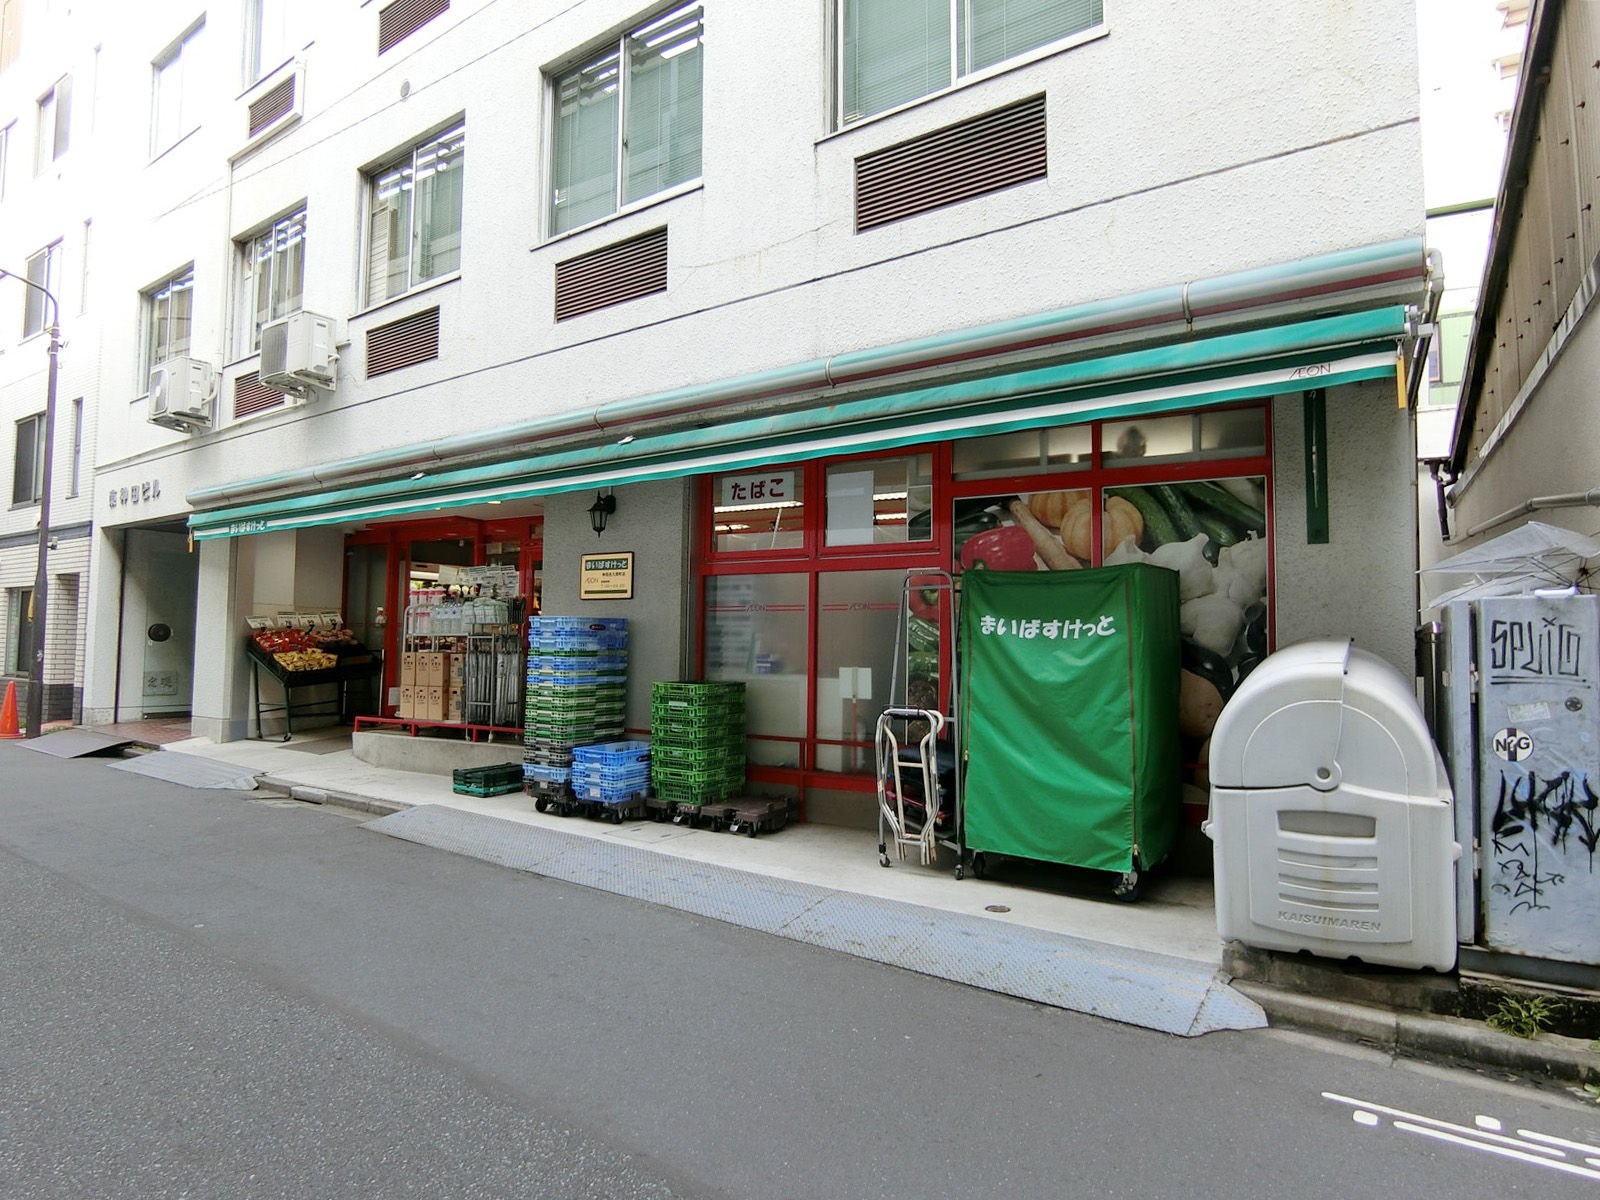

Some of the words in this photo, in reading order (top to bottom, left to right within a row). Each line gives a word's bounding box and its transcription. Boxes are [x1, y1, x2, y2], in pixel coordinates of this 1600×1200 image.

[731, 478, 785, 501] たばこ
[230, 520, 266, 534] まいばすけっと
[585, 560, 628, 570] まいばすけっと
[980, 614, 1117, 640] まいばすけっと
[1278, 911, 1381, 933] KAISUIMAREN
